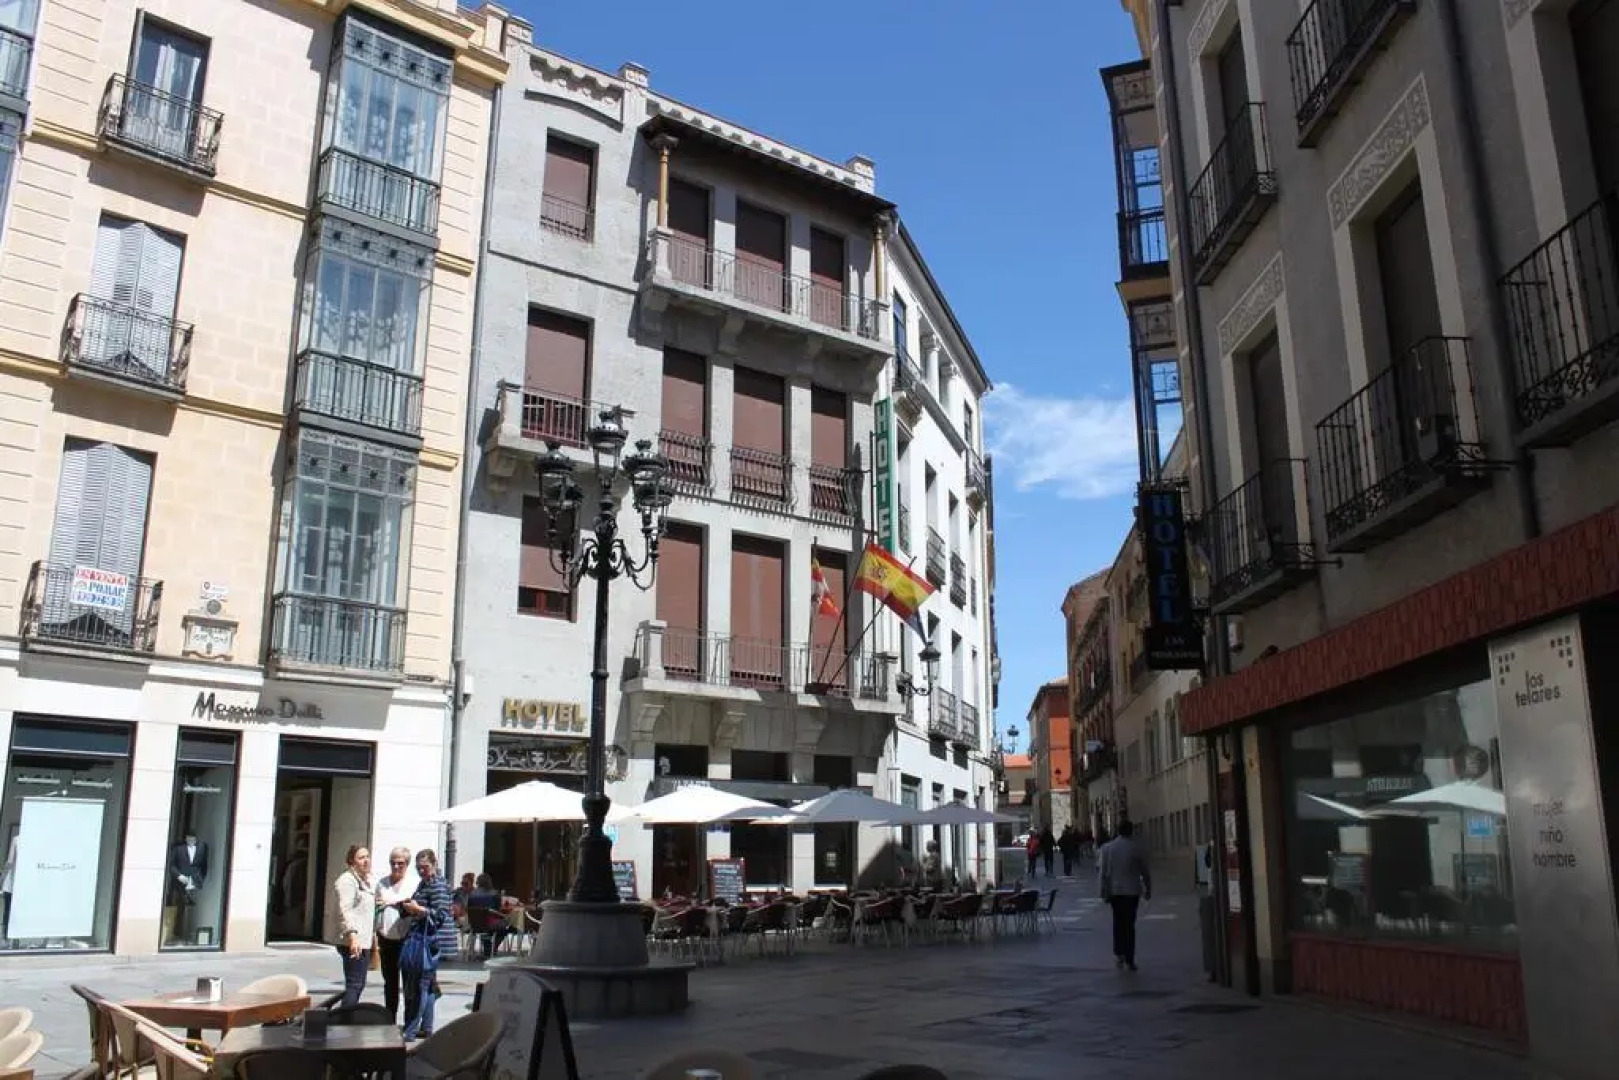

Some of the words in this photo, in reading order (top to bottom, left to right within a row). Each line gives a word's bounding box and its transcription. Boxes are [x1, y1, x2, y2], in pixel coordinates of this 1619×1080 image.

[875, 400, 891, 539] HOTE
[1151, 494, 1184, 624] HOTEL
[1515, 685, 1561, 706] telares
[502, 698, 588, 723] HOTEL
[1532, 852, 1576, 868] hombre
